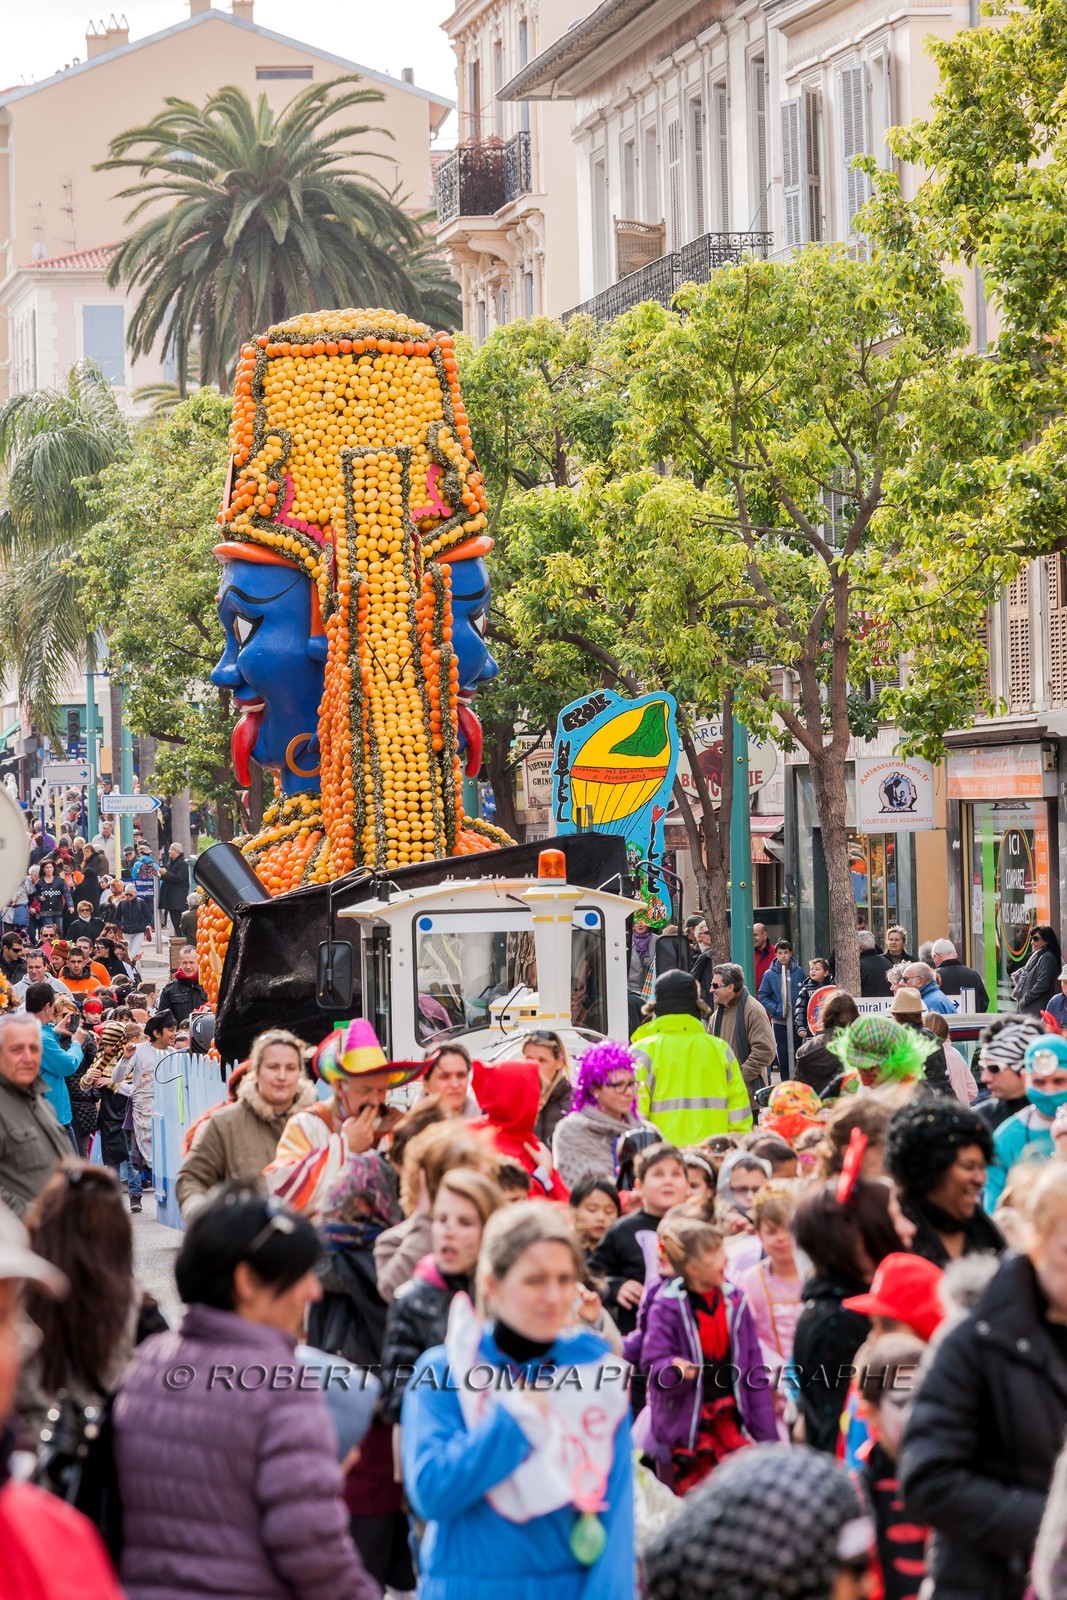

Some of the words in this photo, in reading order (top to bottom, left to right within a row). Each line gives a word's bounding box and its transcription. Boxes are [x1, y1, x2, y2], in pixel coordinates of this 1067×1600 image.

[561, 692, 613, 732] ECOLE
[553, 739, 571, 822] HOTEL
[1008, 834, 1020, 856] ICI
[858, 1002, 882, 1012] miral
